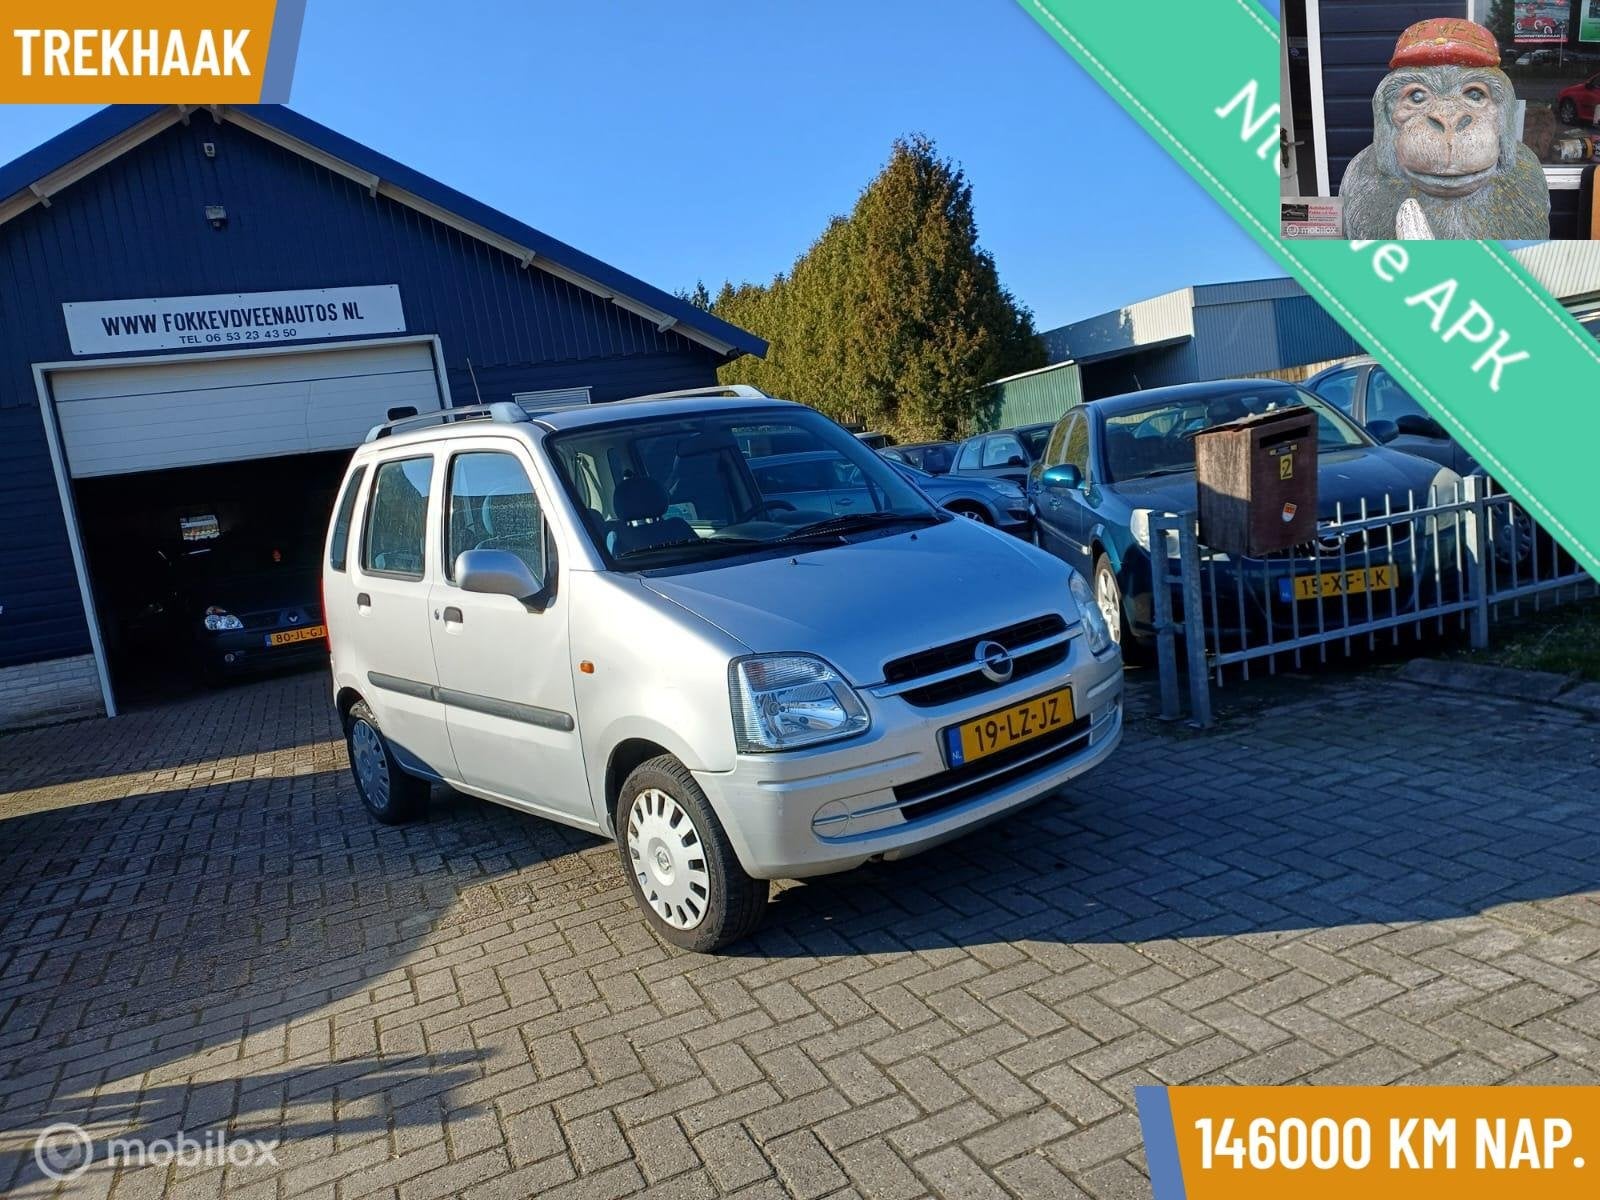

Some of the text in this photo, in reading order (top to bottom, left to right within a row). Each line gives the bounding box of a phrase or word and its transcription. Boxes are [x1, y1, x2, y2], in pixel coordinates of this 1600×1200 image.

[101, 314, 157, 336] WWW
[179, 328, 297, 344] TEL 06 53 23 43 50
[1281, 458, 1292, 477] 2
[276, 627, 323, 643] 80-JL-GJ
[975, 697, 1061, 752] 19-LZ-JZ
